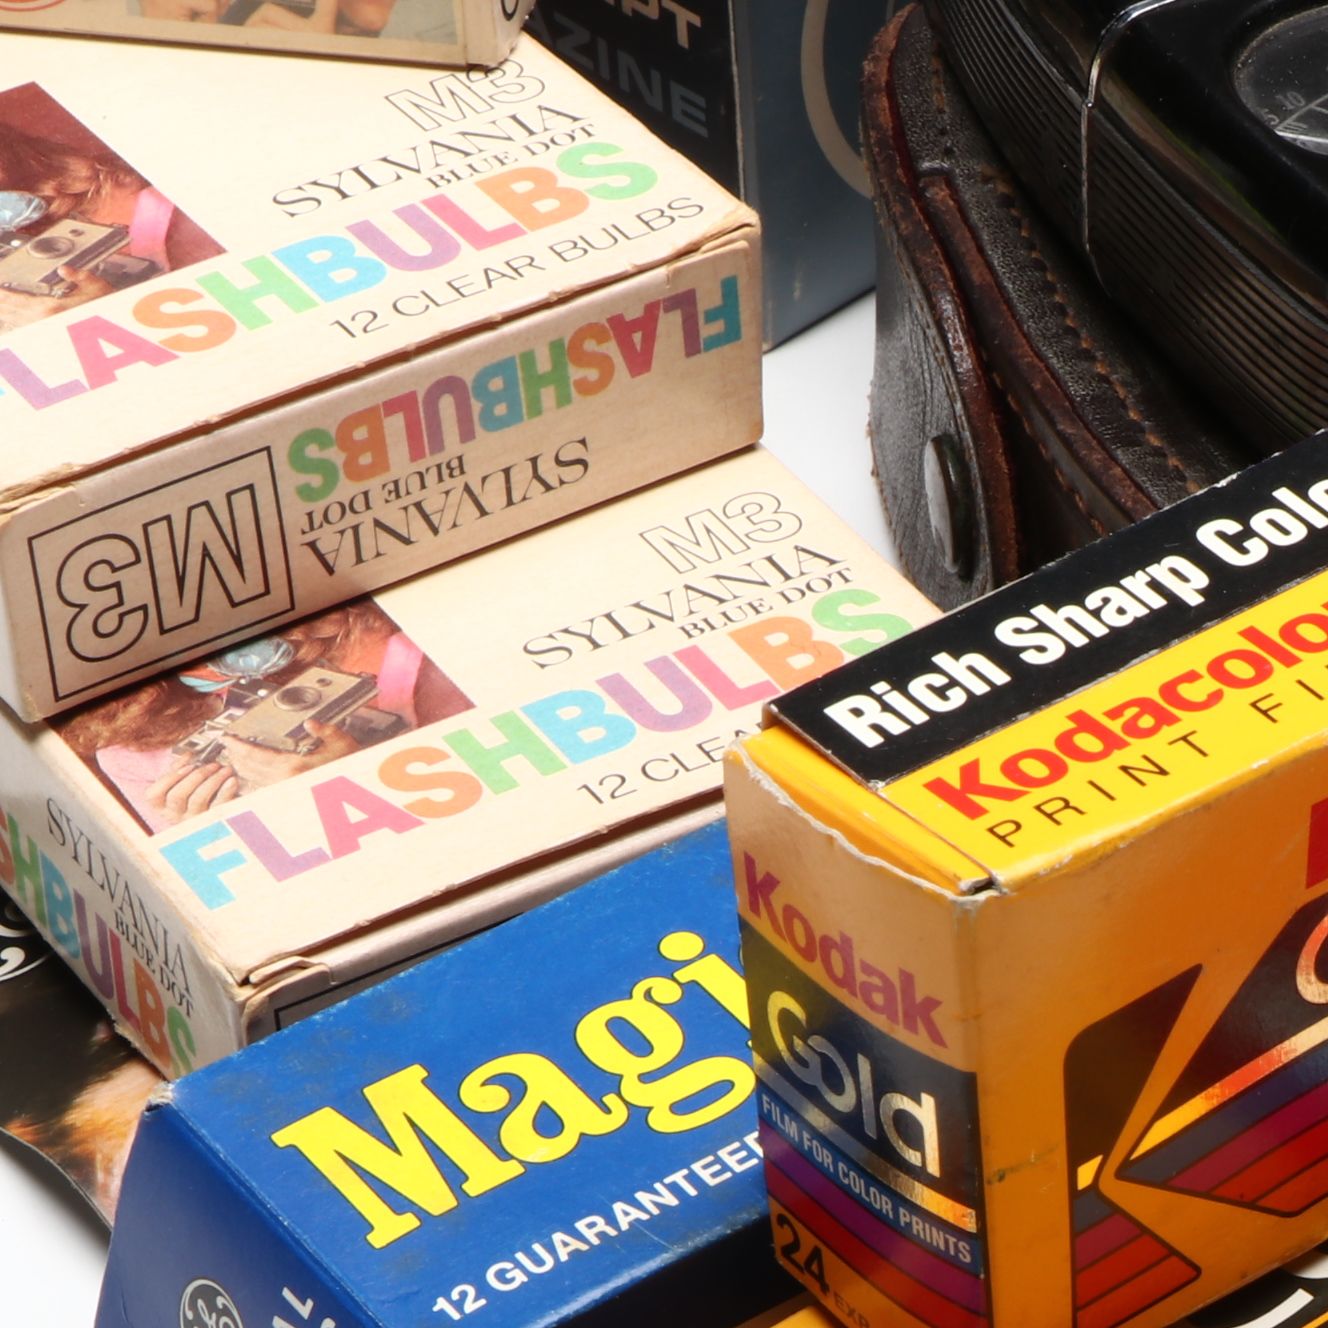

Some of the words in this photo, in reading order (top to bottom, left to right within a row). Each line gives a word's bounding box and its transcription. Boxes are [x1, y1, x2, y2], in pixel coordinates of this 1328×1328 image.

[384, 59, 546, 132] M3
[425, 151, 520, 189] BLUE
[527, 122, 597, 158] DOT
[272, 104, 590, 217] SYLVANIA
[0, 141, 658, 411] LASHBULBS
[330, 310, 389, 339] 12
[393, 254, 546, 318] CLEAR
[549, 196, 705, 264] BULBS
[287, 274, 742, 503] FLASHBULBS
[301, 437, 590, 577] SYLVANIA
[301, 484, 375, 535] DOT
[382, 454, 467, 506] BLUE
[638, 491, 803, 574] M3
[56, 483, 271, 662] M3
[522, 544, 848, 669] SYLVANIA
[677, 598, 774, 640] BLUE
[776, 566, 856, 605] DOT
[823, 649, 1012, 749] Rich
[993, 553, 1209, 667] Sharp
[158, 588, 914, 910] FLASHBULBS
[577, 773, 638, 805] 12
[987, 730, 1209, 848] PRINT
[46, 798, 193, 998] SYLVANIA
[742, 851, 949, 1049] Kodak
[114, 909, 157, 968] BLUE
[159, 965, 195, 1019] DOT
[766, 990, 941, 1178] Gold
[761, 1095, 799, 1143] FILM
[803, 1132, 834, 1172] FOR
[838, 1162, 893, 1221] COLOR
[899, 1206, 972, 1264] PRINTS
[432, 1284, 488, 1321] 12
[777, 1213, 830, 1295] 24
